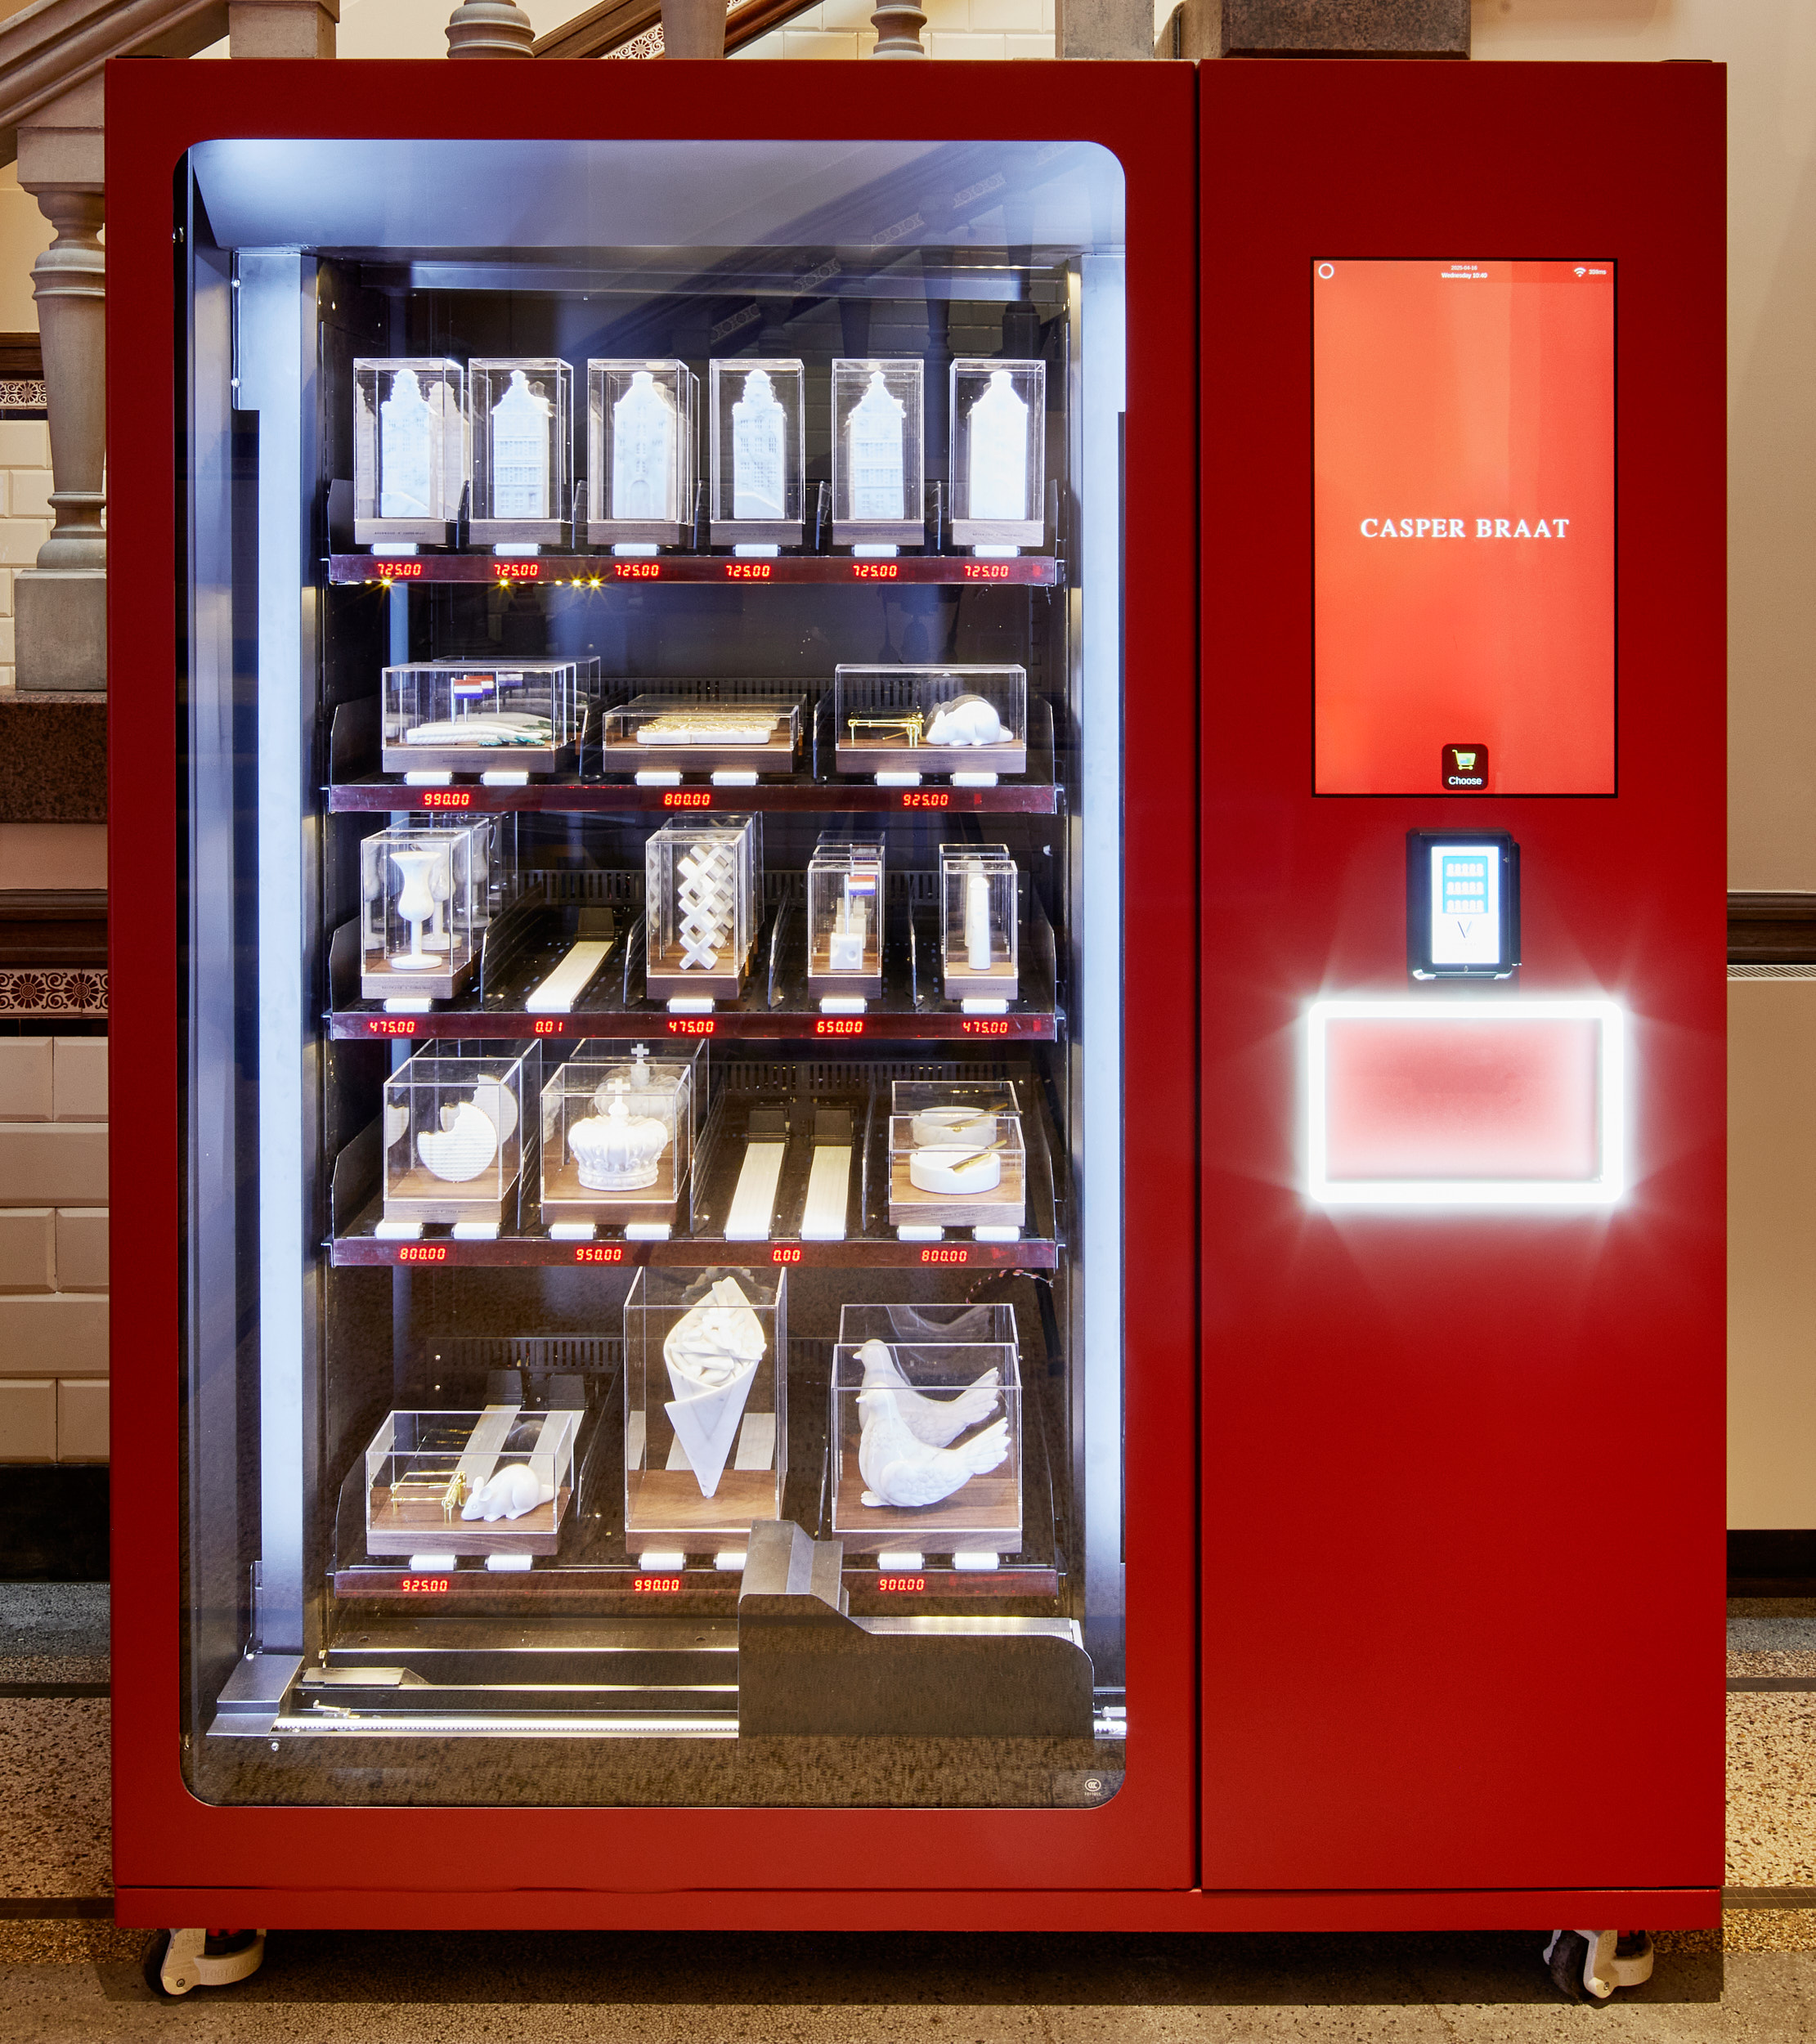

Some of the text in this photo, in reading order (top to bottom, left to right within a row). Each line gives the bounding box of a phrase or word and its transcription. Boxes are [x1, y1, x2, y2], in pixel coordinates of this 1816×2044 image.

[1361, 518, 1569, 538] CASPER BRAAT
[377, 563, 422, 576] 725.00
[494, 563, 539, 576] 725.00
[615, 563, 660, 577] 725.00
[726, 563, 771, 578] 725.00
[853, 564, 898, 578] 725.00
[964, 564, 1009, 578] 725.00
[1448, 776, 1483, 786] Choose
[424, 792, 470, 806] 990.00
[664, 793, 711, 806] 800.00
[904, 794, 948, 807] 925.00
[369, 1020, 416, 1034] 475.00
[535, 1020, 563, 1033] 0.01
[669, 1020, 715, 1034] 475.00
[816, 1020, 863, 1034] 650.00
[962, 1021, 1009, 1034] 475.00
[399, 1246, 446, 1262] 800.00
[576, 1248, 622, 1262] 950.00
[772, 1248, 802, 1262] 0.00
[921, 1249, 968, 1263] 800.00
[401, 1578, 448, 1593] 925.00
[634, 1578, 680, 1593] 990.00
[879, 1577, 926, 1592] 900.00
